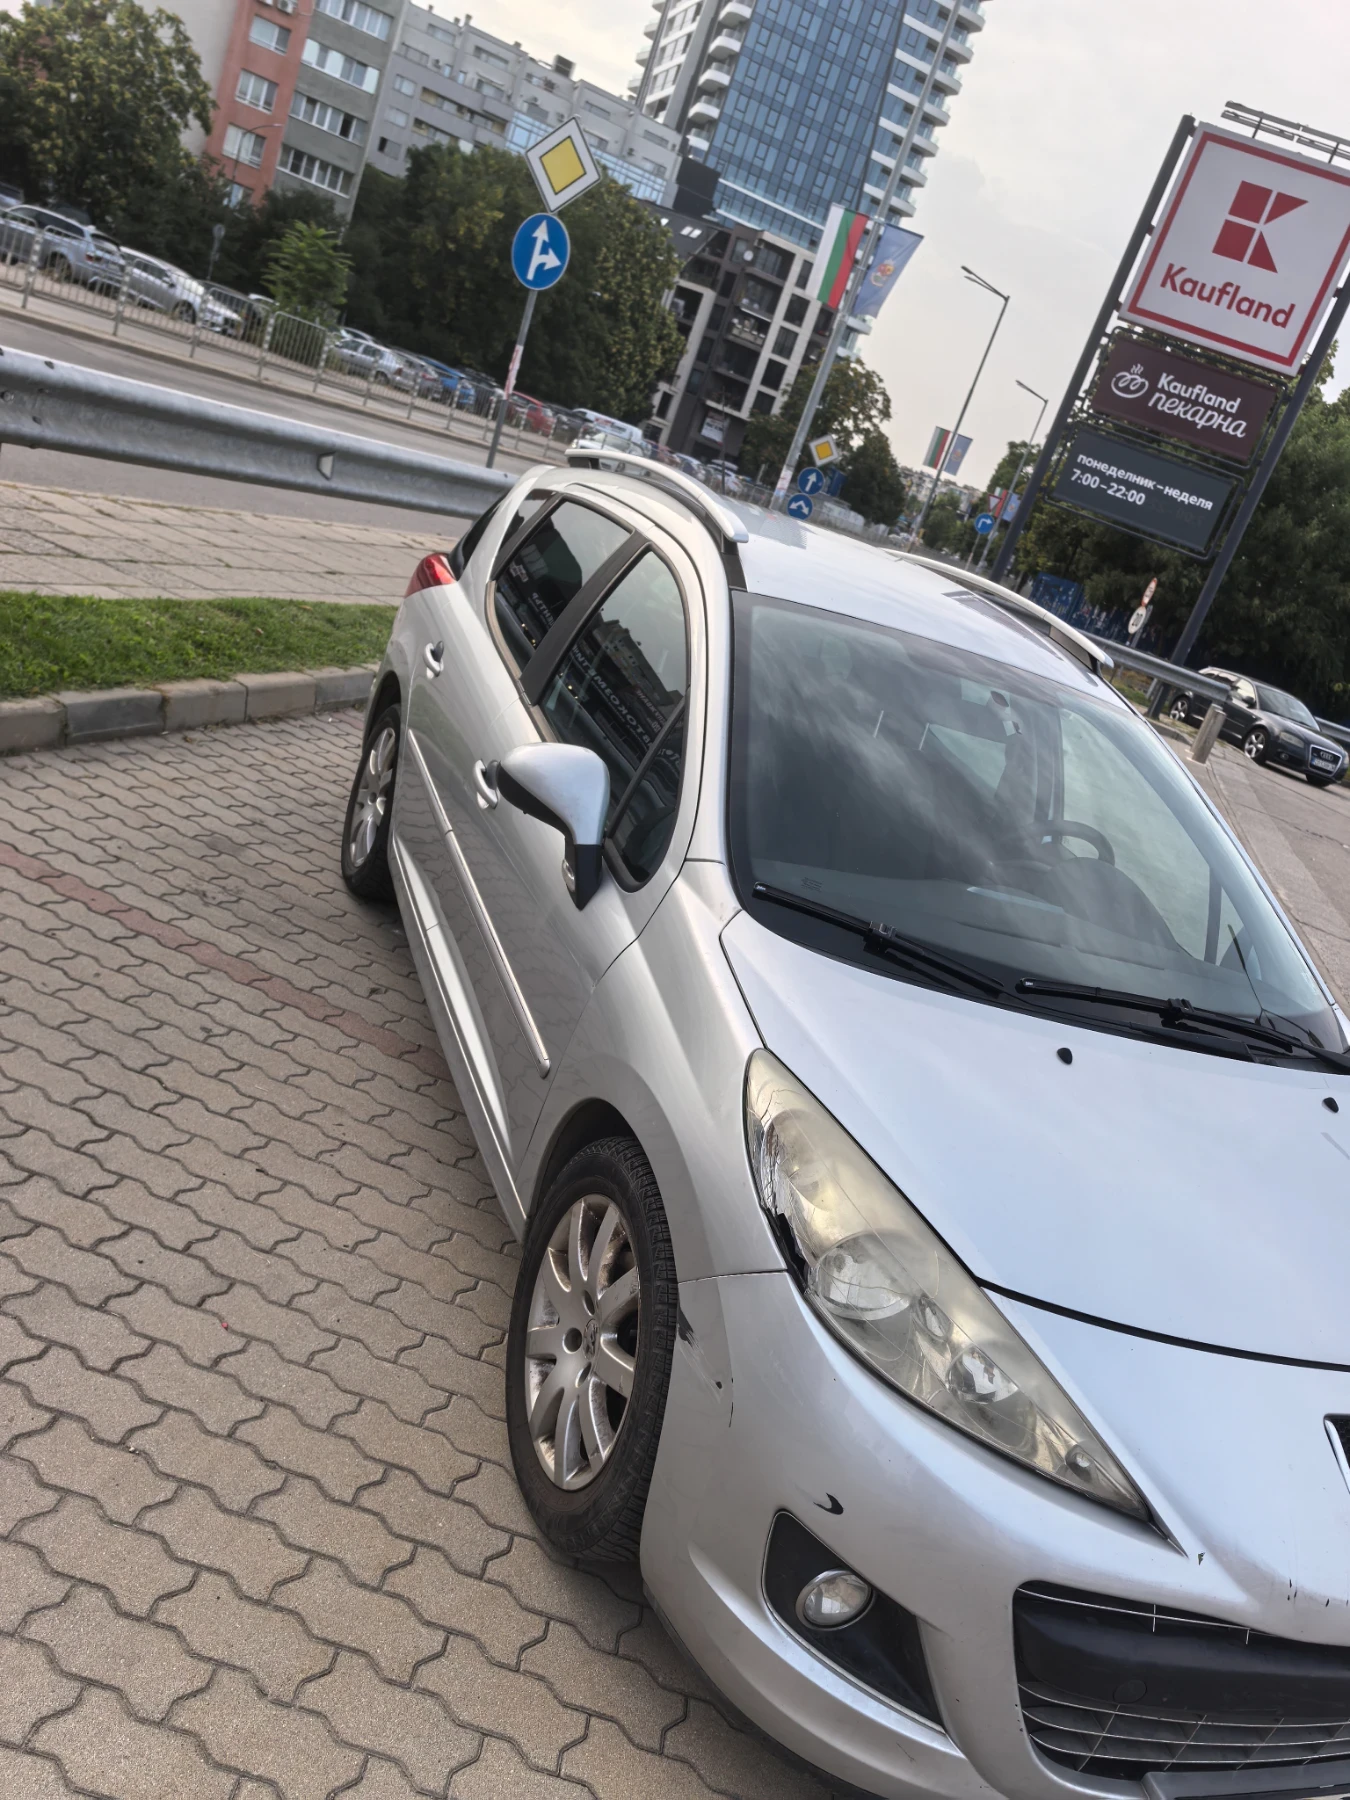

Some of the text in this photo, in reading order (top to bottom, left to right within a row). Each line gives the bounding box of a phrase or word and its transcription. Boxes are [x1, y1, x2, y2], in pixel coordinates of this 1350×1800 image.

[1160, 262, 1296, 329] Kaufland
[1148, 392, 1248, 438] пекарна
[1157, 372, 1242, 414] Kaufland
